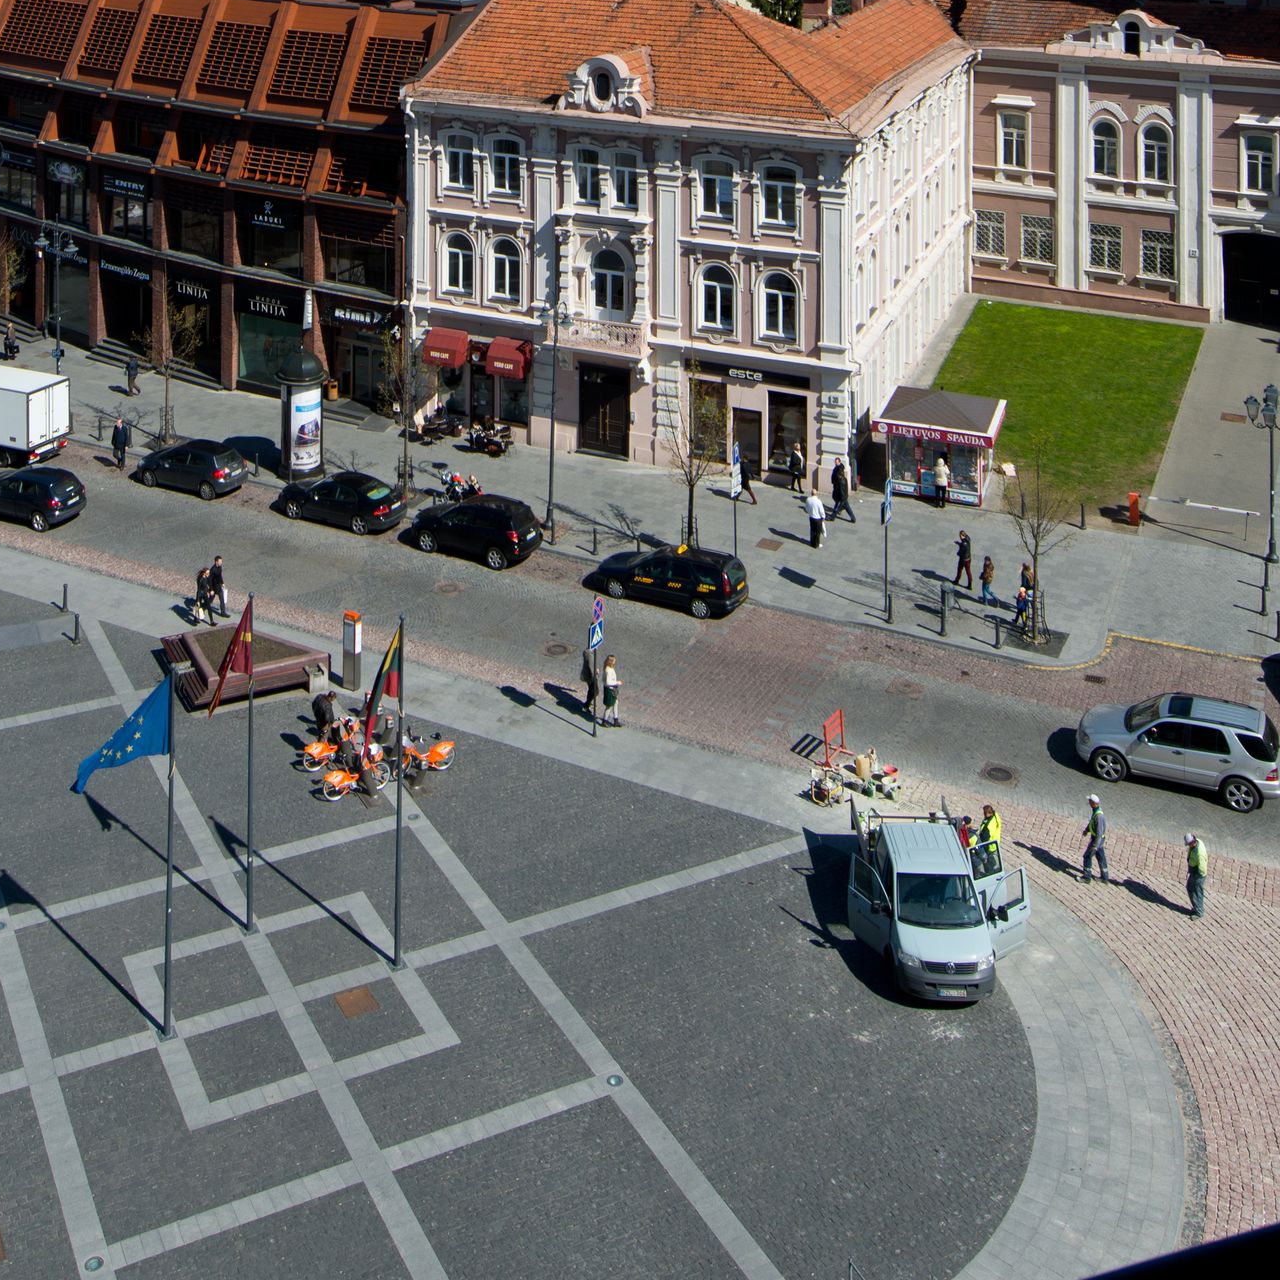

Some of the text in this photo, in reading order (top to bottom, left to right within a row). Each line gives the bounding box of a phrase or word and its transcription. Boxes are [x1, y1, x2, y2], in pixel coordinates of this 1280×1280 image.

[115, 179, 145, 191] ENTRY
[132, 267, 150, 281] Zegna
[177, 283, 208, 299] LINIJA
[250, 301, 285, 317] LINIJA
[729, 368, 763, 381] este
[892, 425, 986, 447] LIETUVOS SPAUDA
